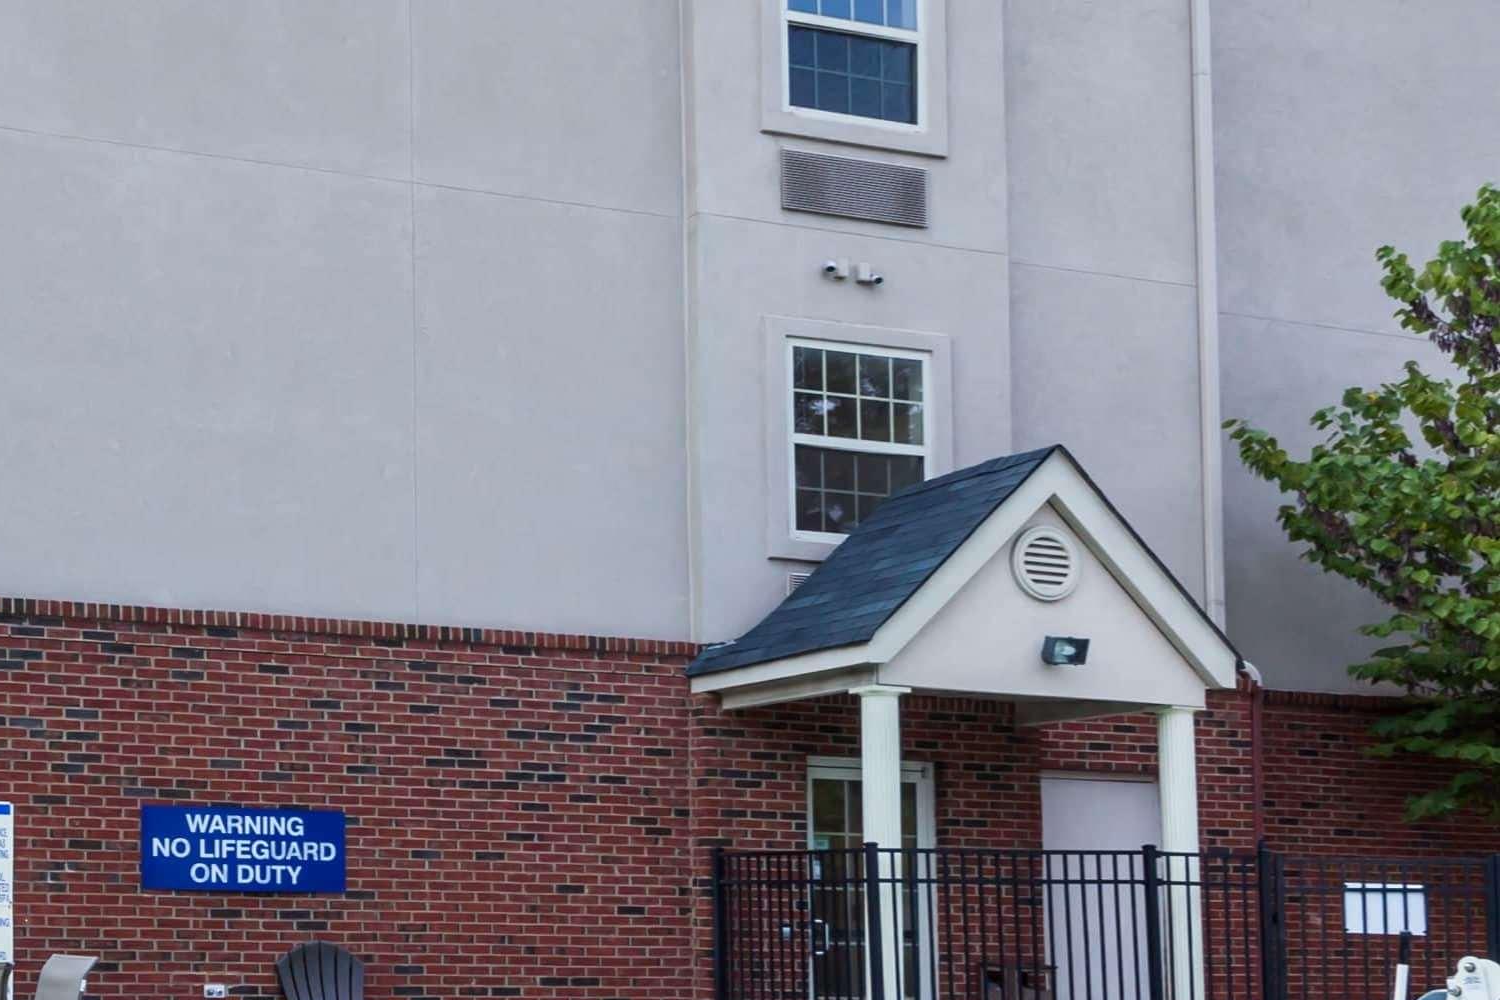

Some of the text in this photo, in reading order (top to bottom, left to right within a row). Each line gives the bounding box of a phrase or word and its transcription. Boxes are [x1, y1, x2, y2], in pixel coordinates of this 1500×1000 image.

[185, 813, 305, 837] WARNING
[151, 836, 337, 862] NO LIFEGUARD
[189, 862, 302, 886] ON DUTY
